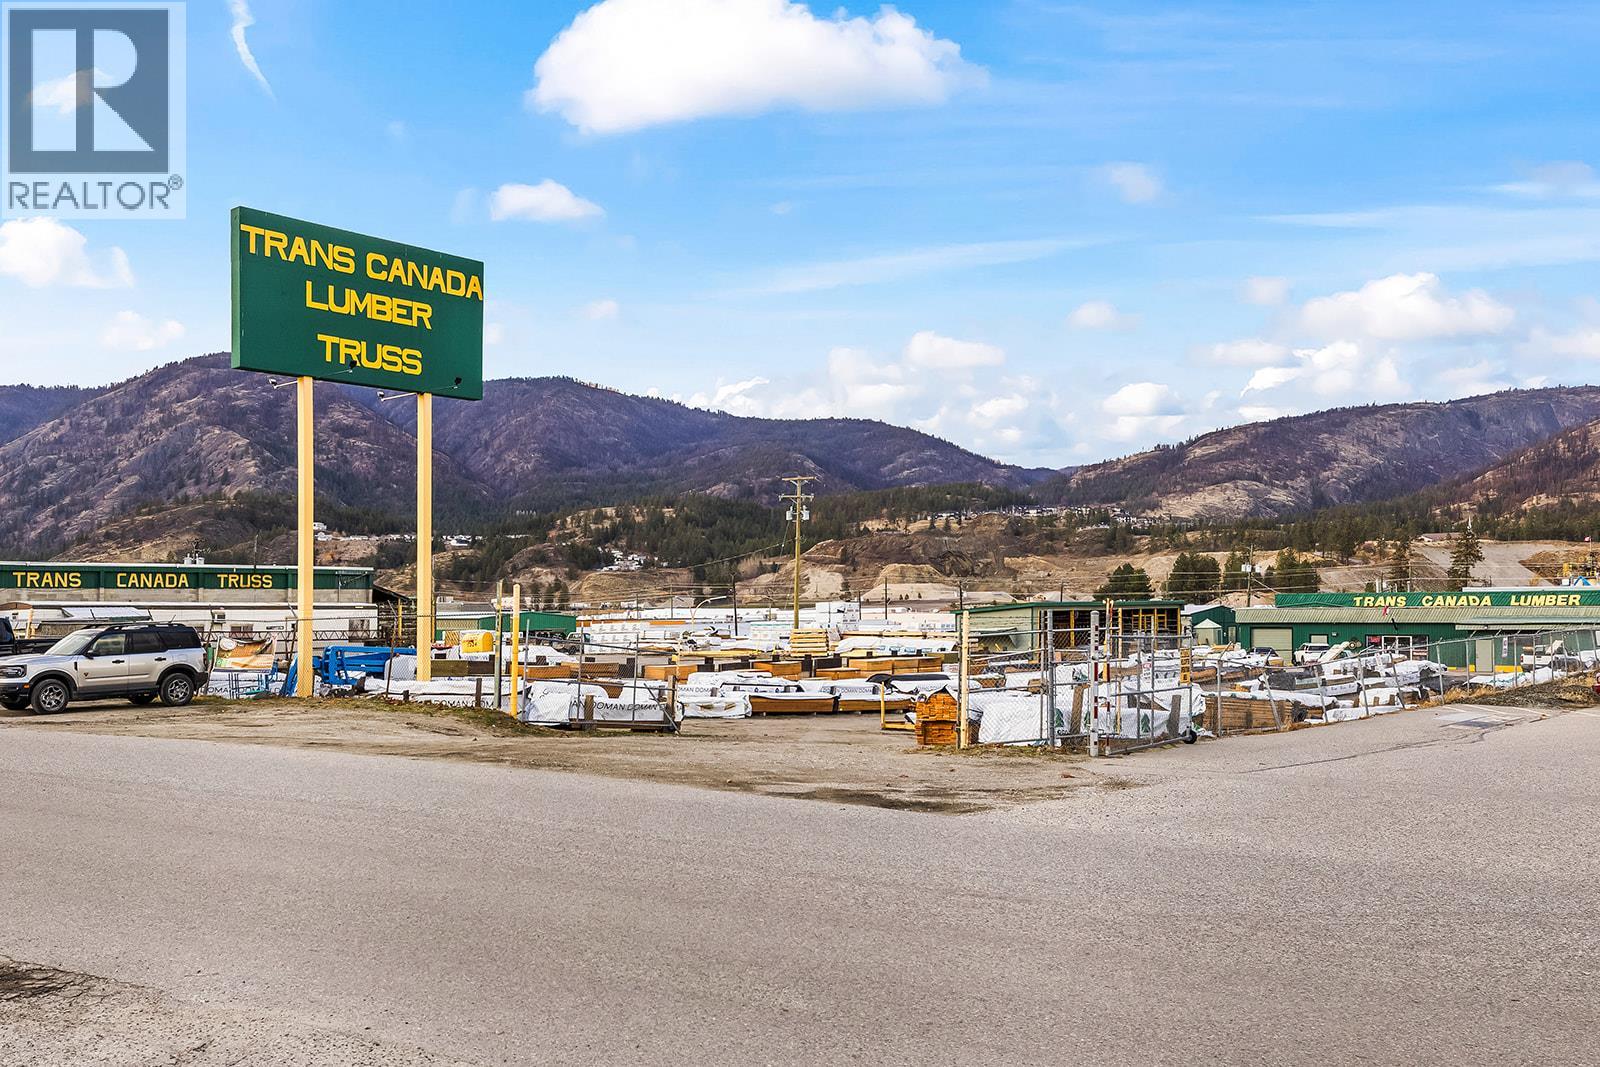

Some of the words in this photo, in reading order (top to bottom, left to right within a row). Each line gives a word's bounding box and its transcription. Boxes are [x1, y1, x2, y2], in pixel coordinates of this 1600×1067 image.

[240, 223, 355, 274] TRANS
[366, 252, 484, 301] CANADA
[305, 280, 432, 330] LUMBER
[317, 333, 423, 375] TRUSS
[13, 572, 82, 588] TRANS
[116, 572, 189, 588] CANADA
[217, 573, 273, 588] TRUSS
[1353, 596, 1407, 607] TRANS
[1421, 596, 1492, 607] CANADA
[1510, 594, 1582, 606] LUMBER
